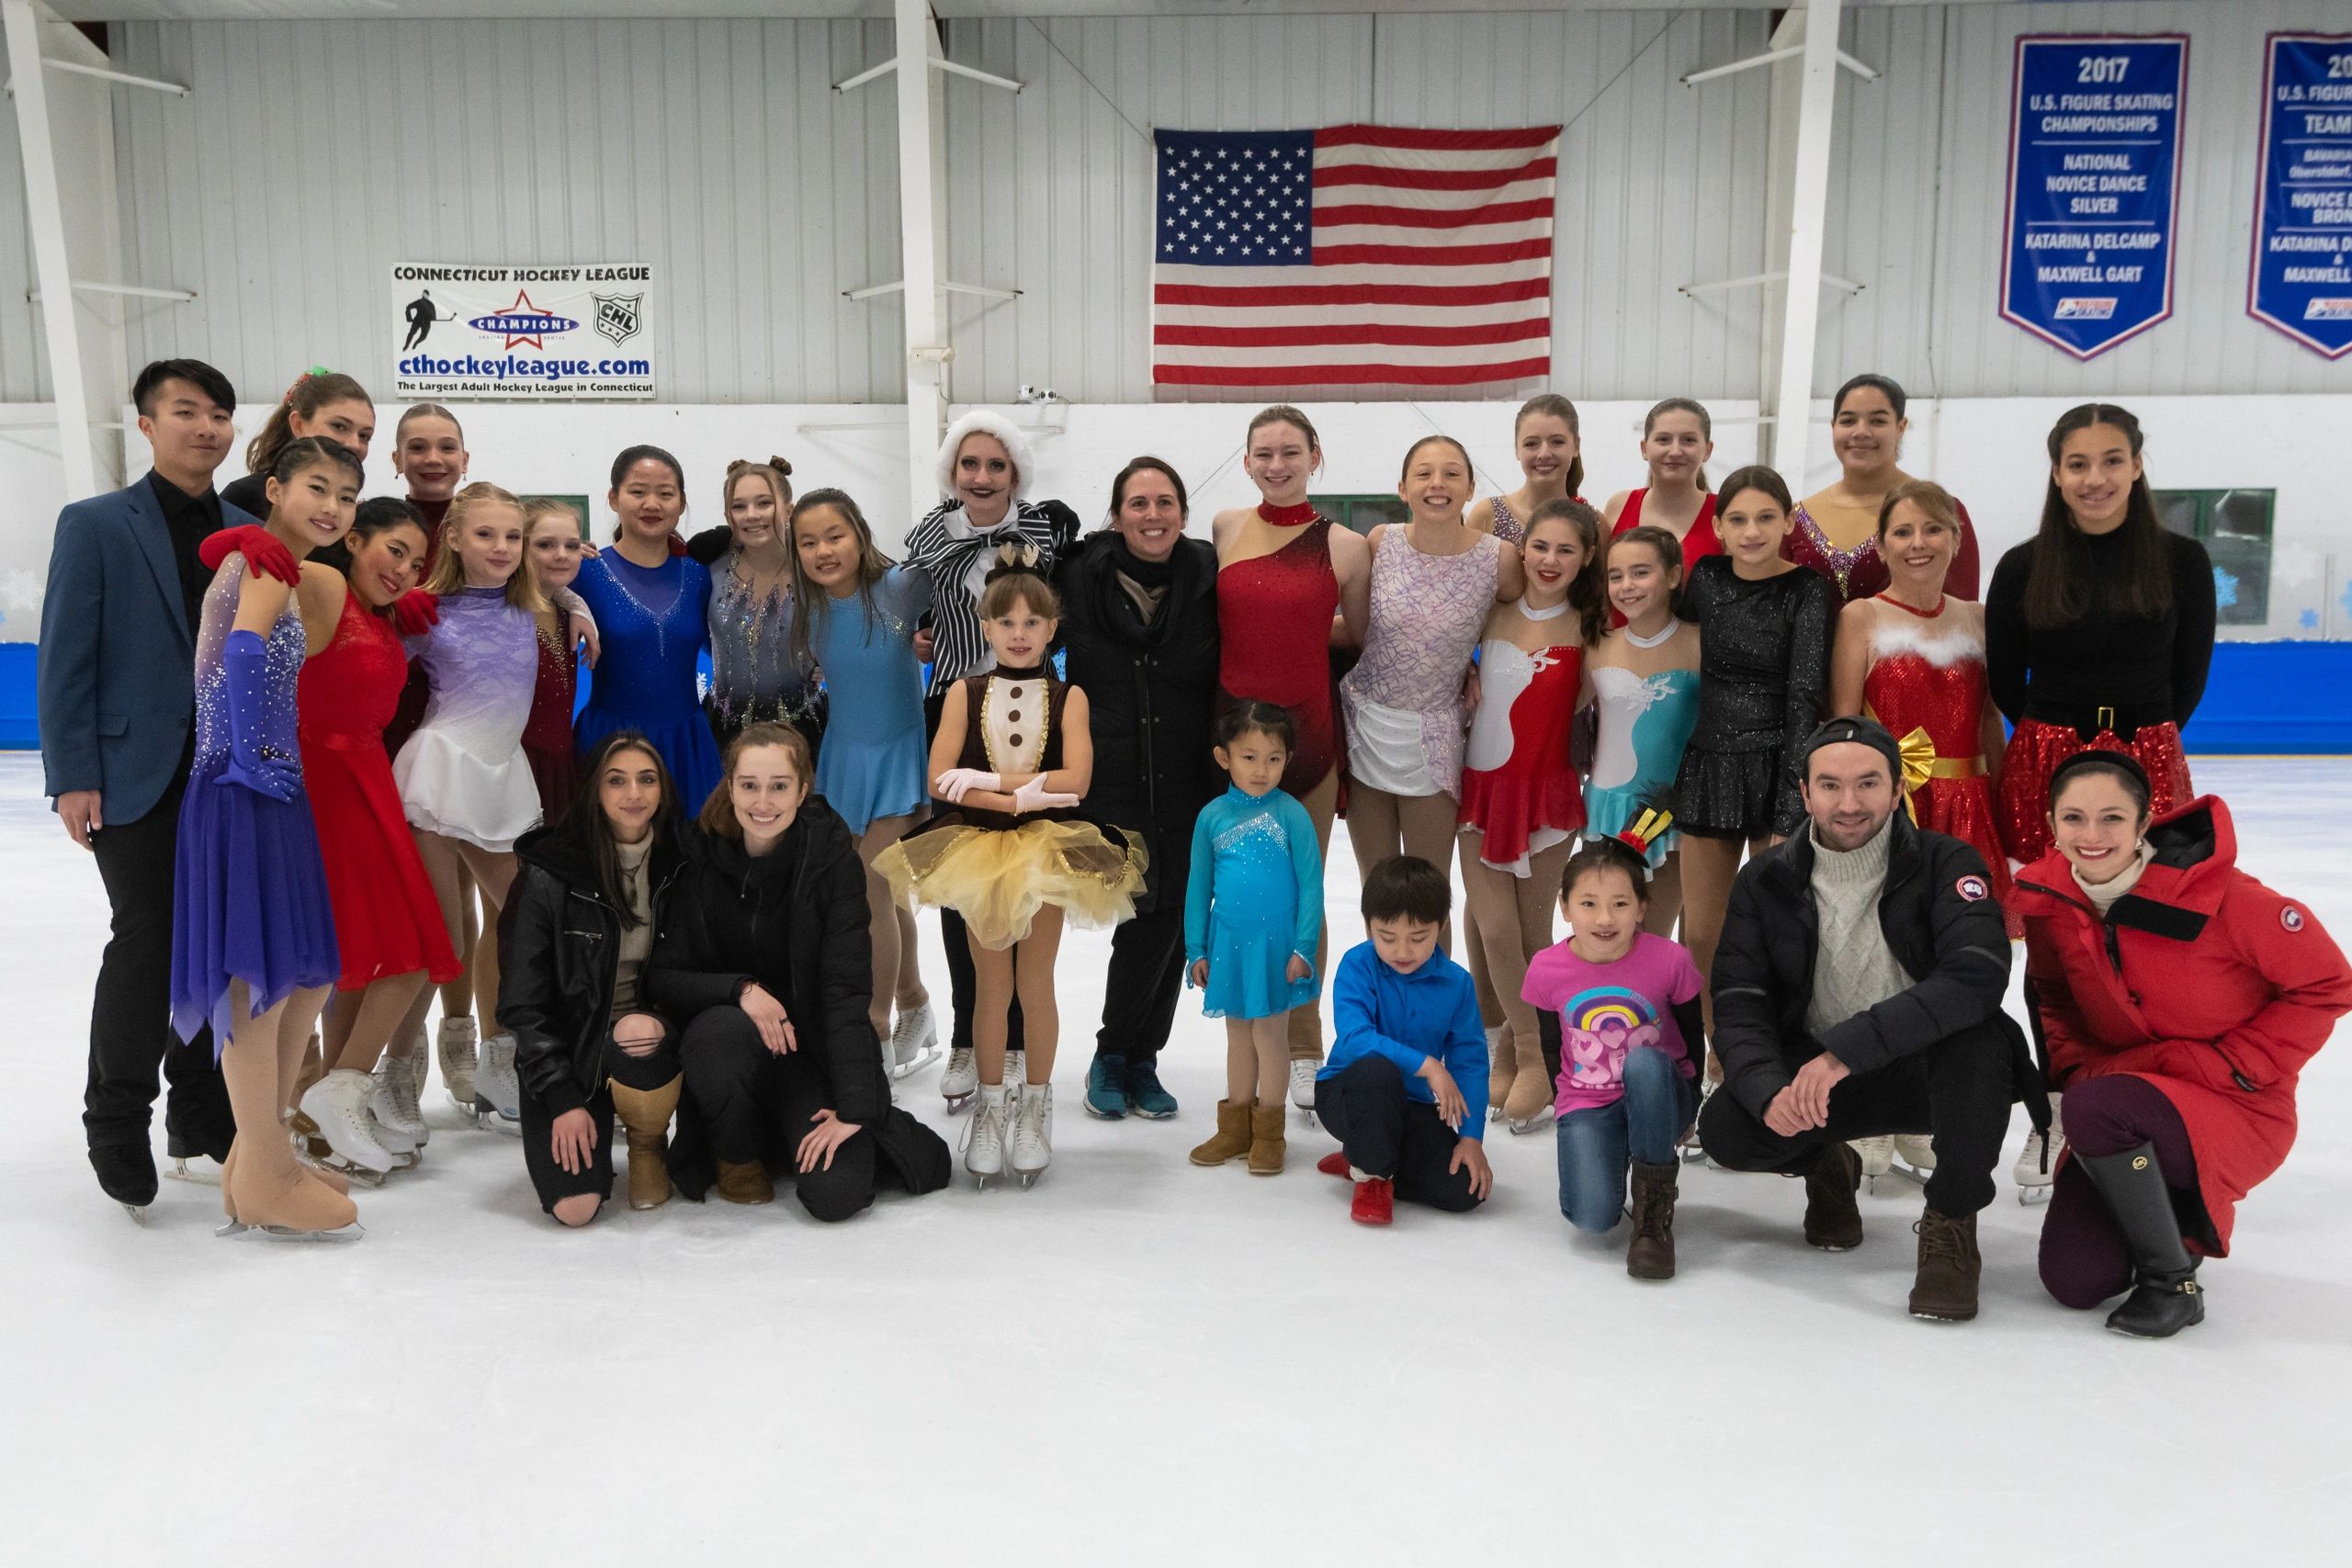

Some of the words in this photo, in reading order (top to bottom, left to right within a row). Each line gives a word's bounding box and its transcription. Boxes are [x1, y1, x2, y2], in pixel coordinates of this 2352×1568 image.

[2077, 57, 2130, 83] 2017
[2278, 85, 2306, 101] U.S.
[2030, 95, 2058, 111] U.S.
[2060, 95, 2111, 111] FIGURE
[2113, 94, 2174, 110] SKATING
[2041, 117, 2158, 133] CHAMPIONSHIPS
[2304, 115, 2352, 133] TEAM
[2064, 154, 2130, 171] NATIONAL
[2046, 176, 2096, 192] NOVICE
[2098, 175, 2147, 192] DANCE
[2070, 197, 2118, 213] SILVER
[2291, 192, 2346, 208] NOVICE
[2025, 233, 2091, 249] KATARINA
[2093, 233, 2160, 249] DELCAMP
[2269, 236, 2338, 252] KATARINA
[2086, 251, 2096, 263] &
[394, 266, 508, 281] CONNECTICUT
[514, 268, 581, 281] HOCKEY
[586, 267, 650, 281] LEAGUE
[2038, 266, 2104, 282] MAXWELL
[2106, 266, 2143, 282] GART
[2283, 266, 2351, 283] MAXWELL
[477, 319, 571, 331] CHAMPIONS
[600, 303, 634, 332] CHL
[399, 354, 650, 380] cthockeyleague.com
[398, 382, 415, 390] The
[419, 382, 458, 392] Largest
[460, 382, 491, 391] Adult
[493, 382, 534, 393] Hockey
[536, 383, 574, 393] League
[576, 382, 587, 391] in
[590, 382, 653, 392] Connecticut
